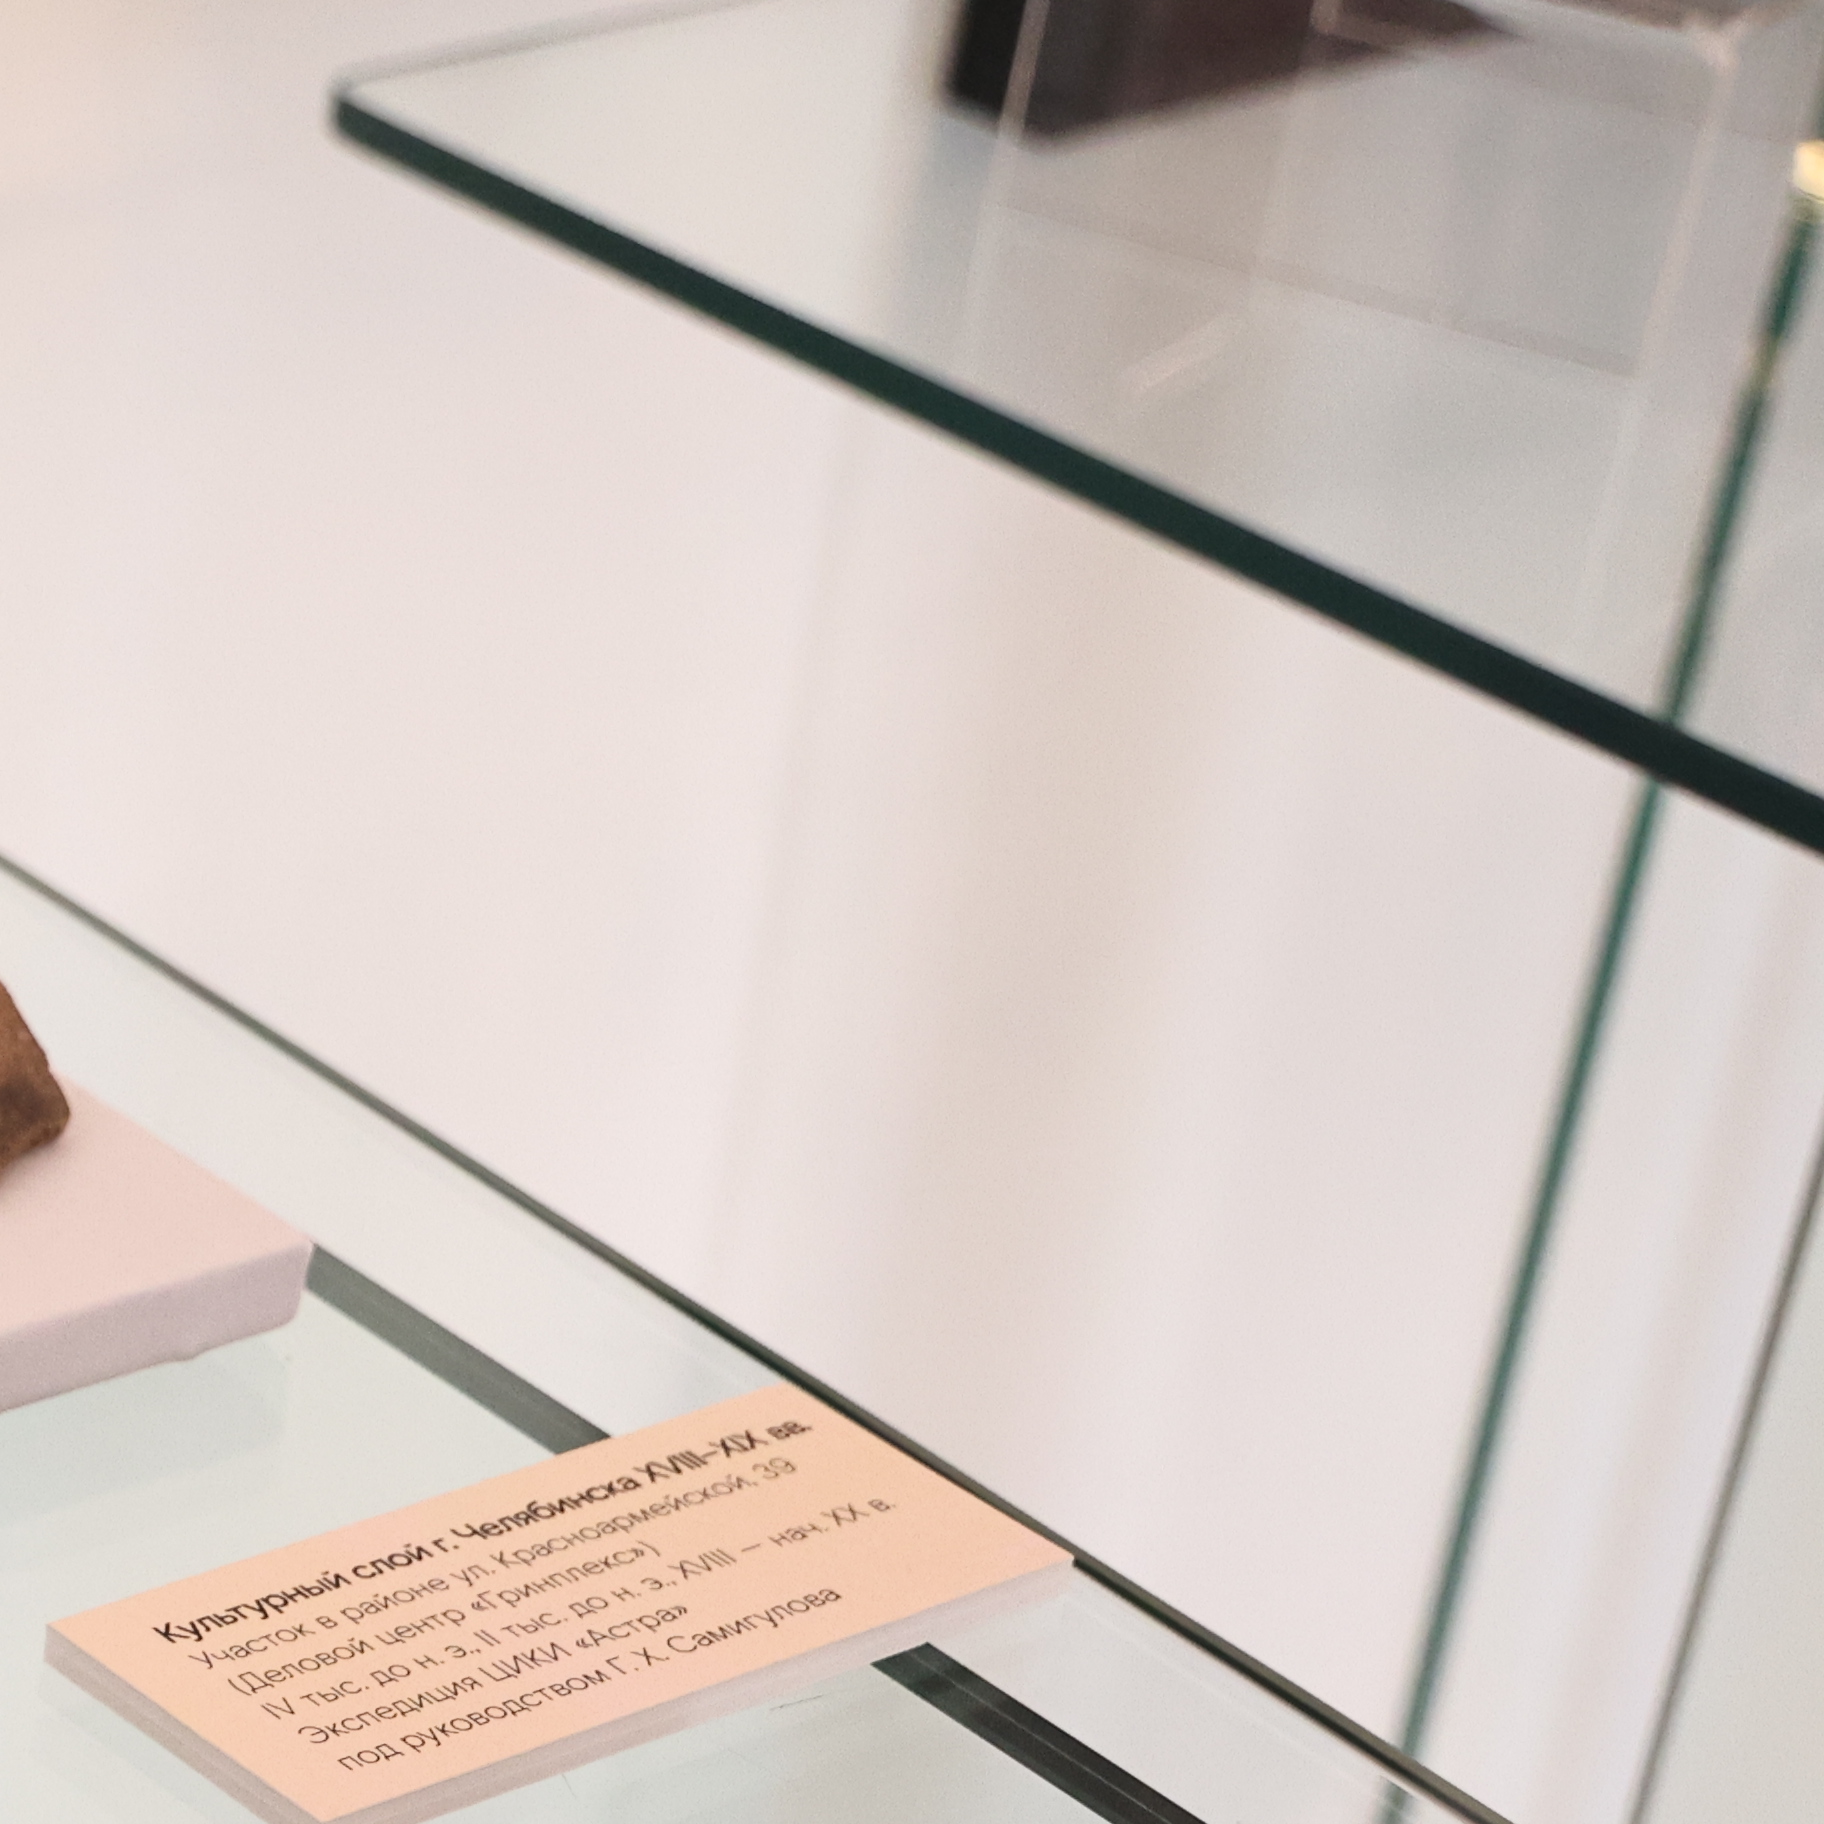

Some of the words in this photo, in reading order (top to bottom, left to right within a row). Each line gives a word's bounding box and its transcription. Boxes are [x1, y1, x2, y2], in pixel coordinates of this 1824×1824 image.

[151, 1569, 352, 1644] Культурный
[350, 1542, 434, 1580] слой
[430, 1536, 460, 1553] г.
[448, 1475, 643, 1540] Челябинска
[764, 1420, 813, 1441] вв.
[186, 1622, 316, 1670] Участок
[313, 1614, 339, 1630] в
[338, 1577, 451, 1625] районе
[448, 1563, 496, 1588] ул.
[750, 1456, 798, 1480] 39
[298, 1679, 370, 1707] тыс.
[368, 1663, 412, 1688] до
[411, 1653, 446, 1670] н.
[442, 1643, 482, 1659] э.,
[499, 1611, 569, 1638] тыс.
[566, 1595, 610, 1619] до
[609, 1585, 642, 1602] н.
[638, 1576, 678, 1591] э.,
[767, 1522, 829, 1547] нач.
[866, 1497, 896, 1513] в.
[225, 1636, 376, 1697] (Деловой
[373, 1607, 467, 1646] центр
[296, 1675, 484, 1745] Экспедиция
[476, 1640, 573, 1683] ЦИКИ
[335, 1741, 406, 1771] под
[398, 1668, 612, 1754] руководством
[603, 1654, 640, 1675] Г.
[664, 1587, 843, 1654] Самигулова
